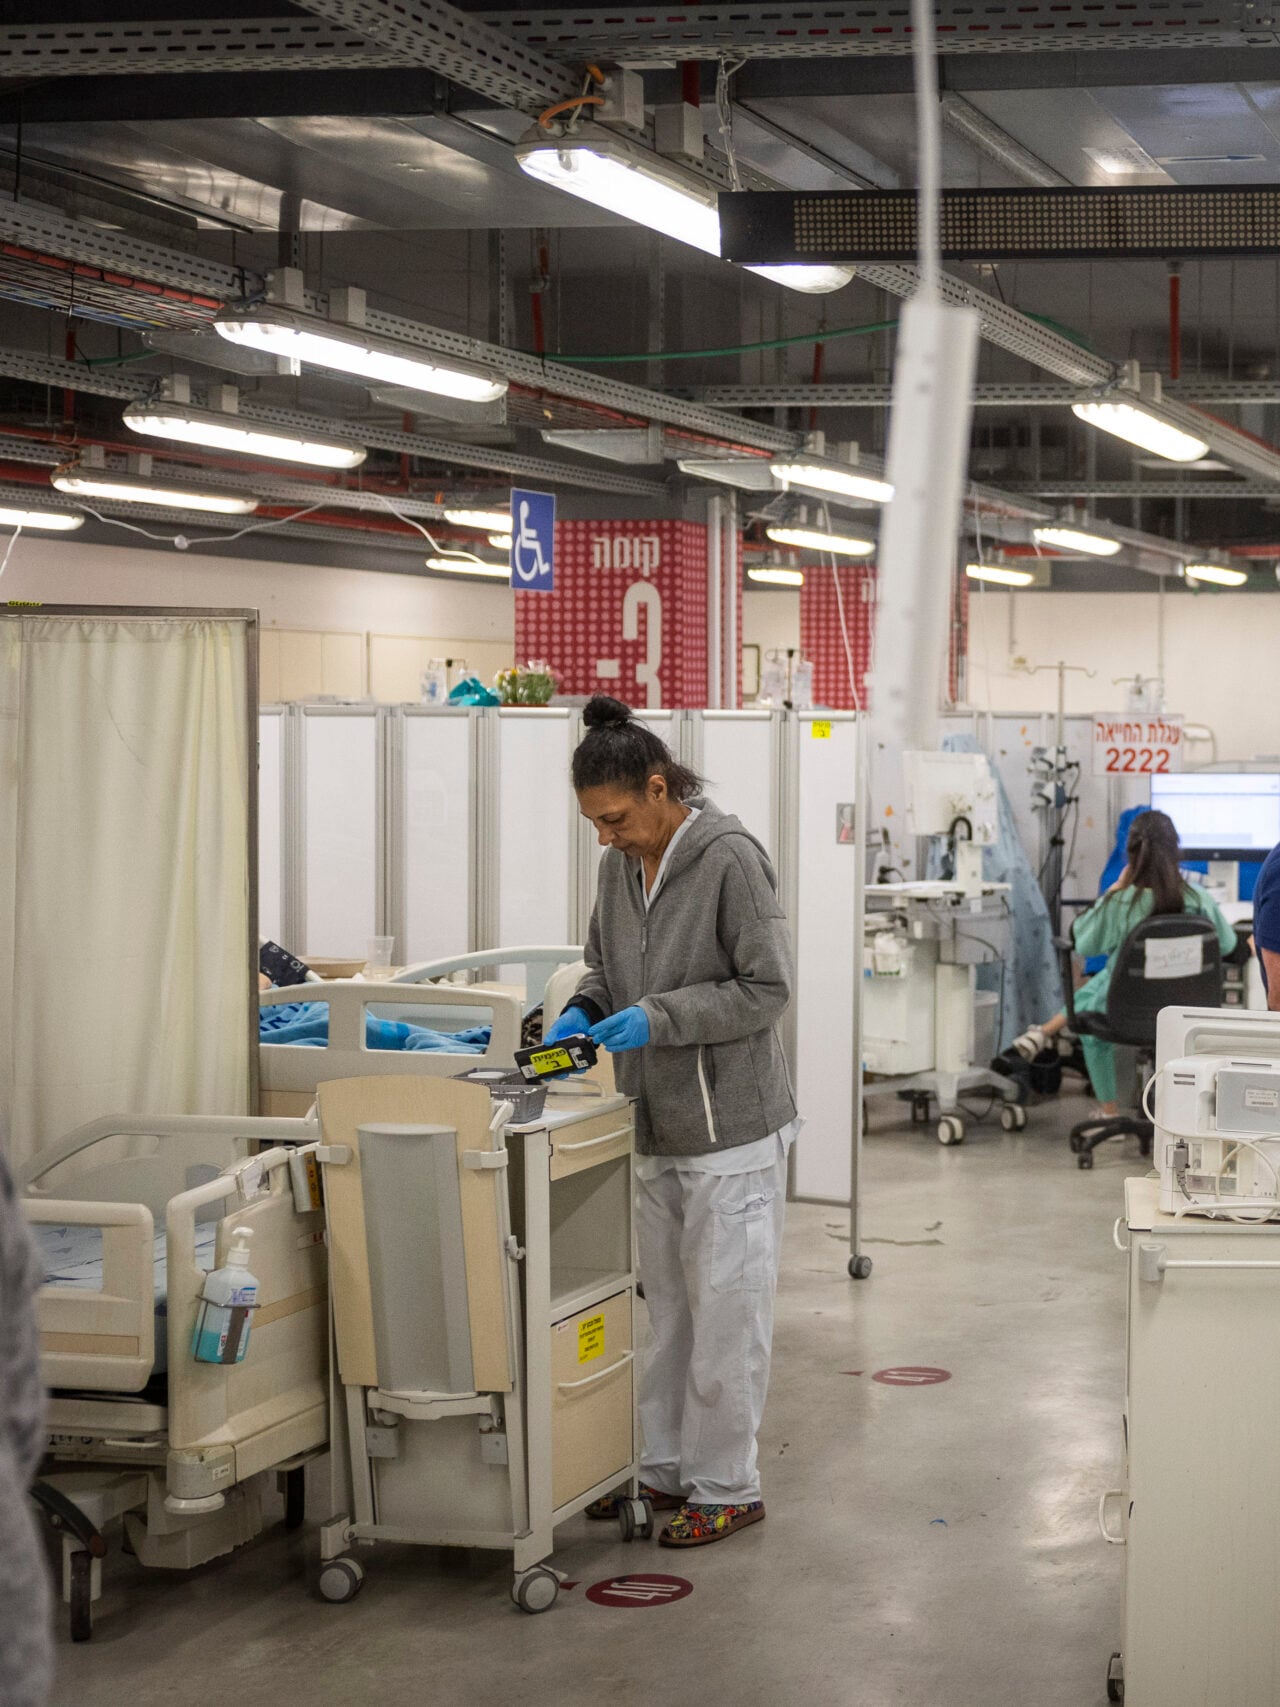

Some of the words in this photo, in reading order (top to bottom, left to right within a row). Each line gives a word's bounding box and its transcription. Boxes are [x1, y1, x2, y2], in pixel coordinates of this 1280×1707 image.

[593, 536, 660, 578] קומה
[1096, 722, 1142, 743] החייאה
[1147, 717, 1181, 745] עגלת
[1105, 747, 1170, 773] 2222
[601, 1581, 682, 1600] 40
